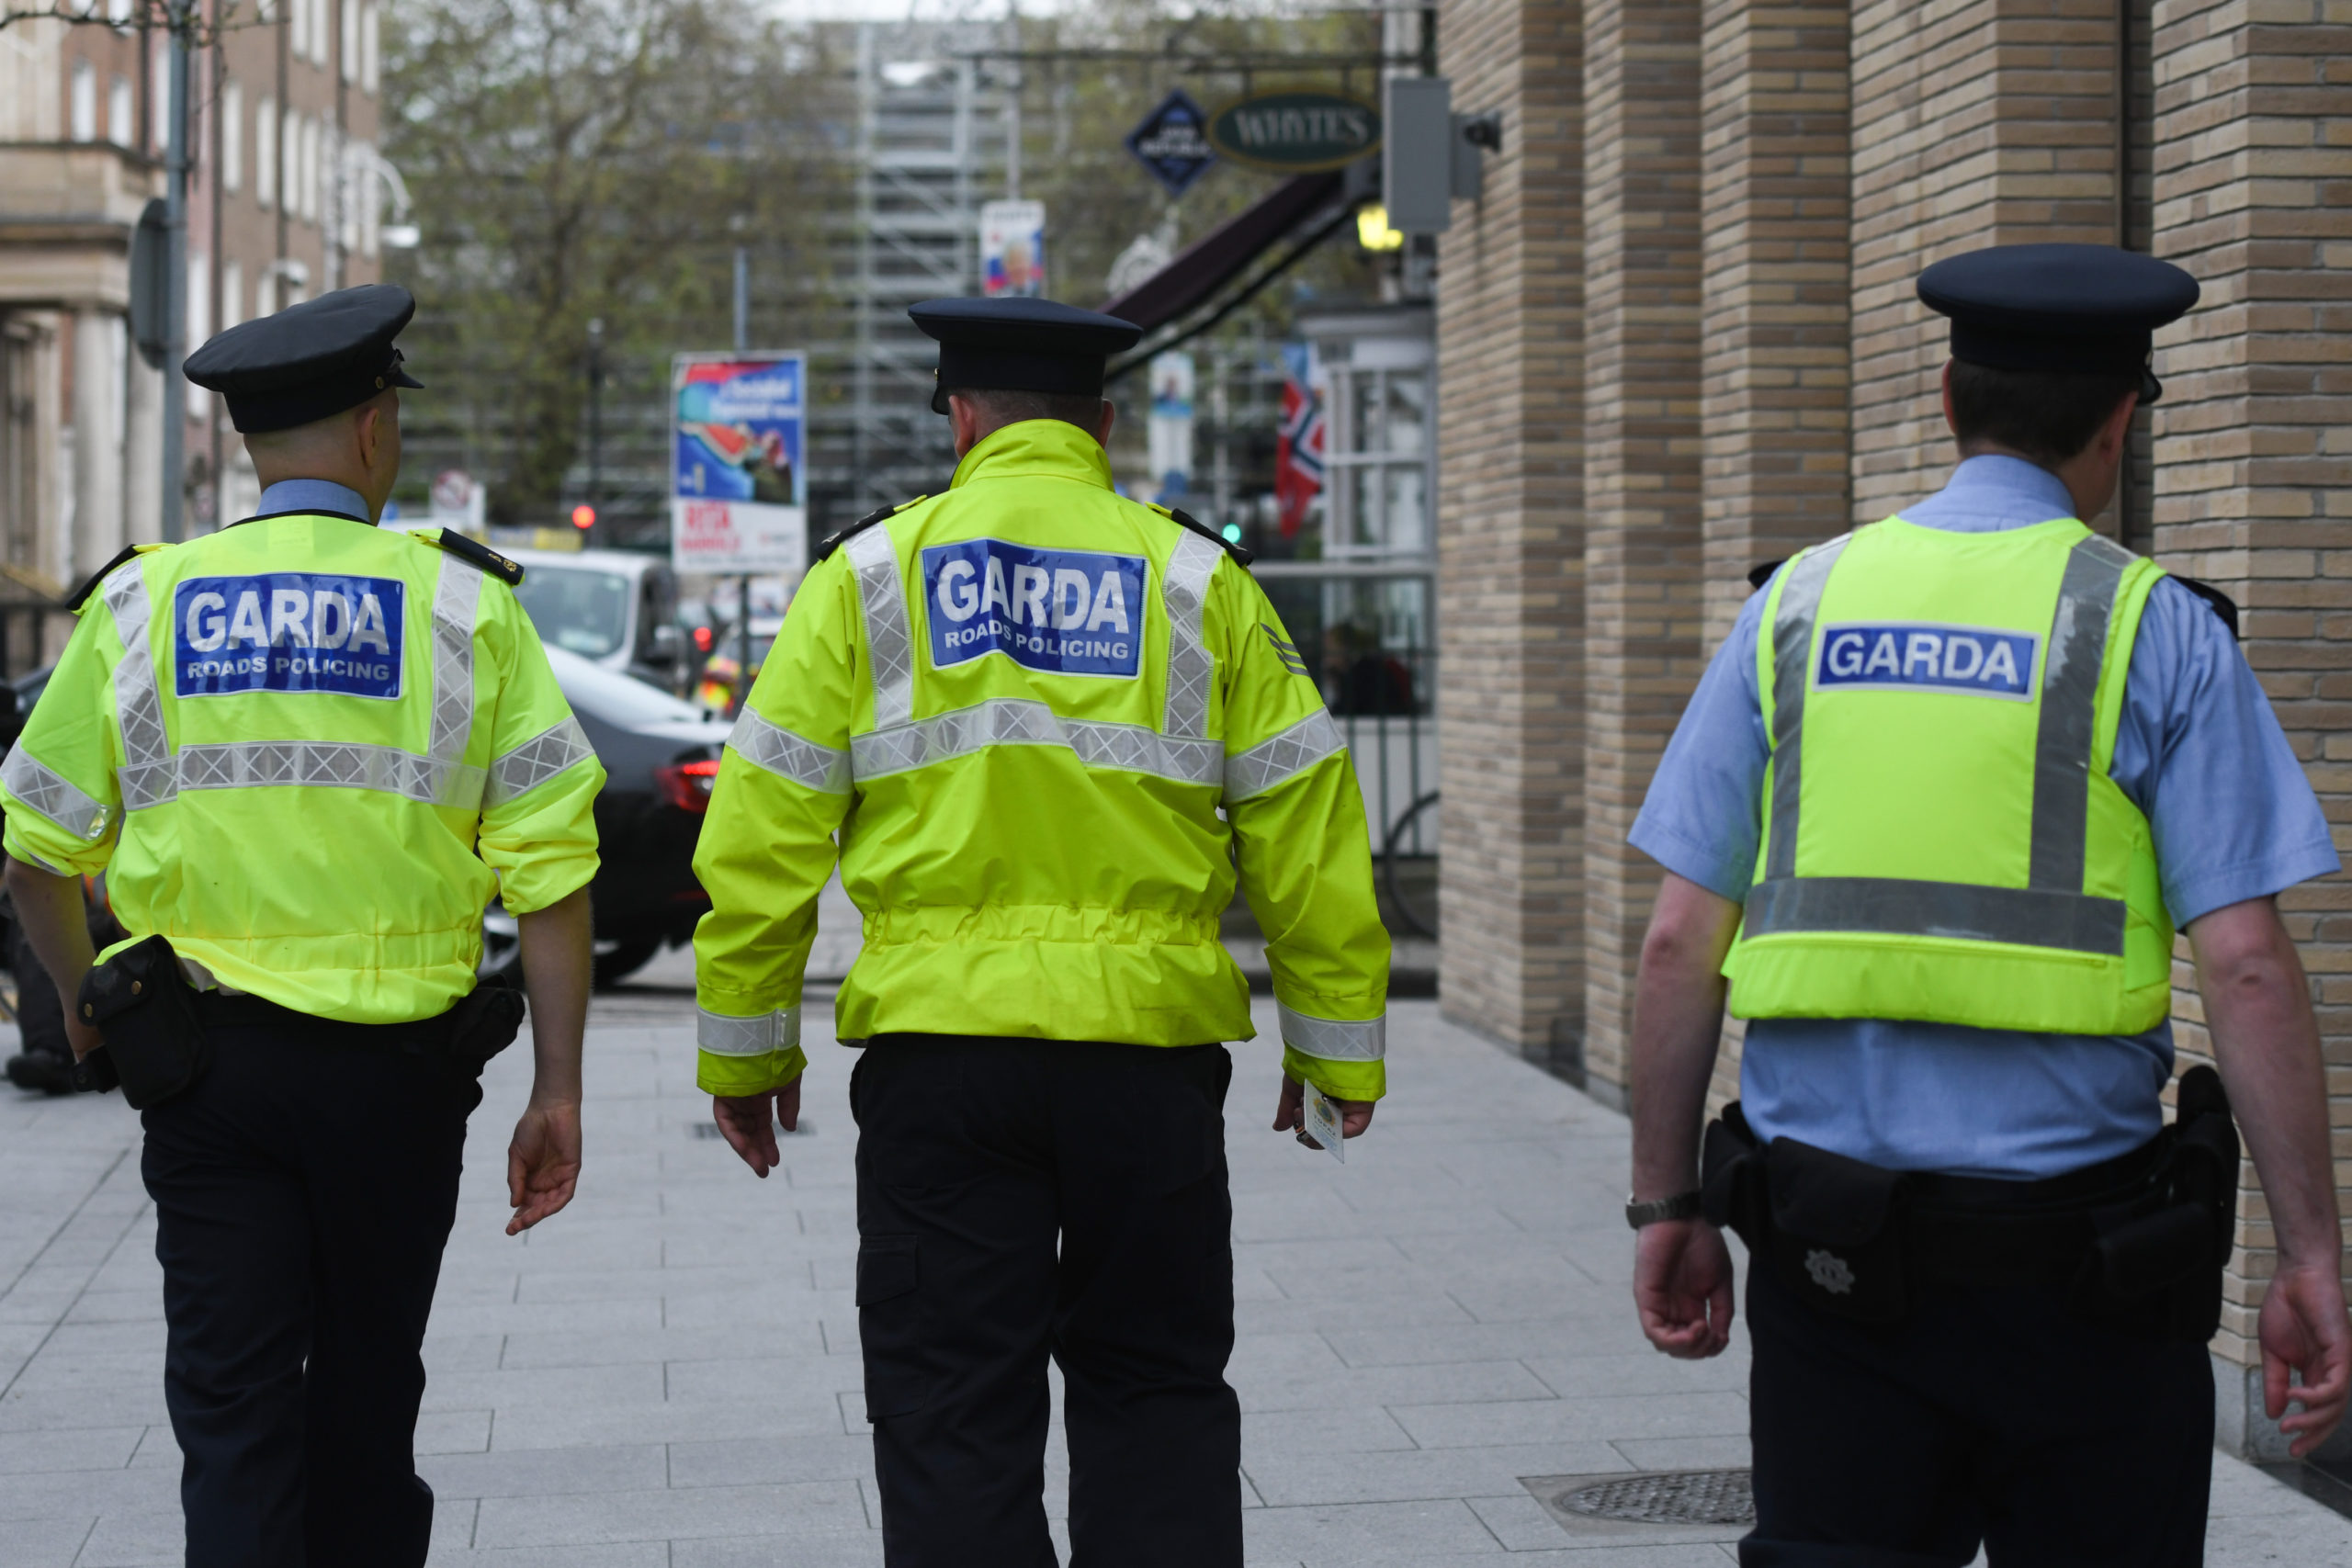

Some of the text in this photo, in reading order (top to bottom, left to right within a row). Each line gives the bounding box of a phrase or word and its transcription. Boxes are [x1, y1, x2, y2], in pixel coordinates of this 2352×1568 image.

[937, 555, 1129, 634] GARDA
[186, 589, 390, 655] GARDA
[944, 619, 1128, 660] ROADS POLICING
[187, 656, 390, 681] ROADS POLICING
[1827, 632, 2018, 684] GARDA
